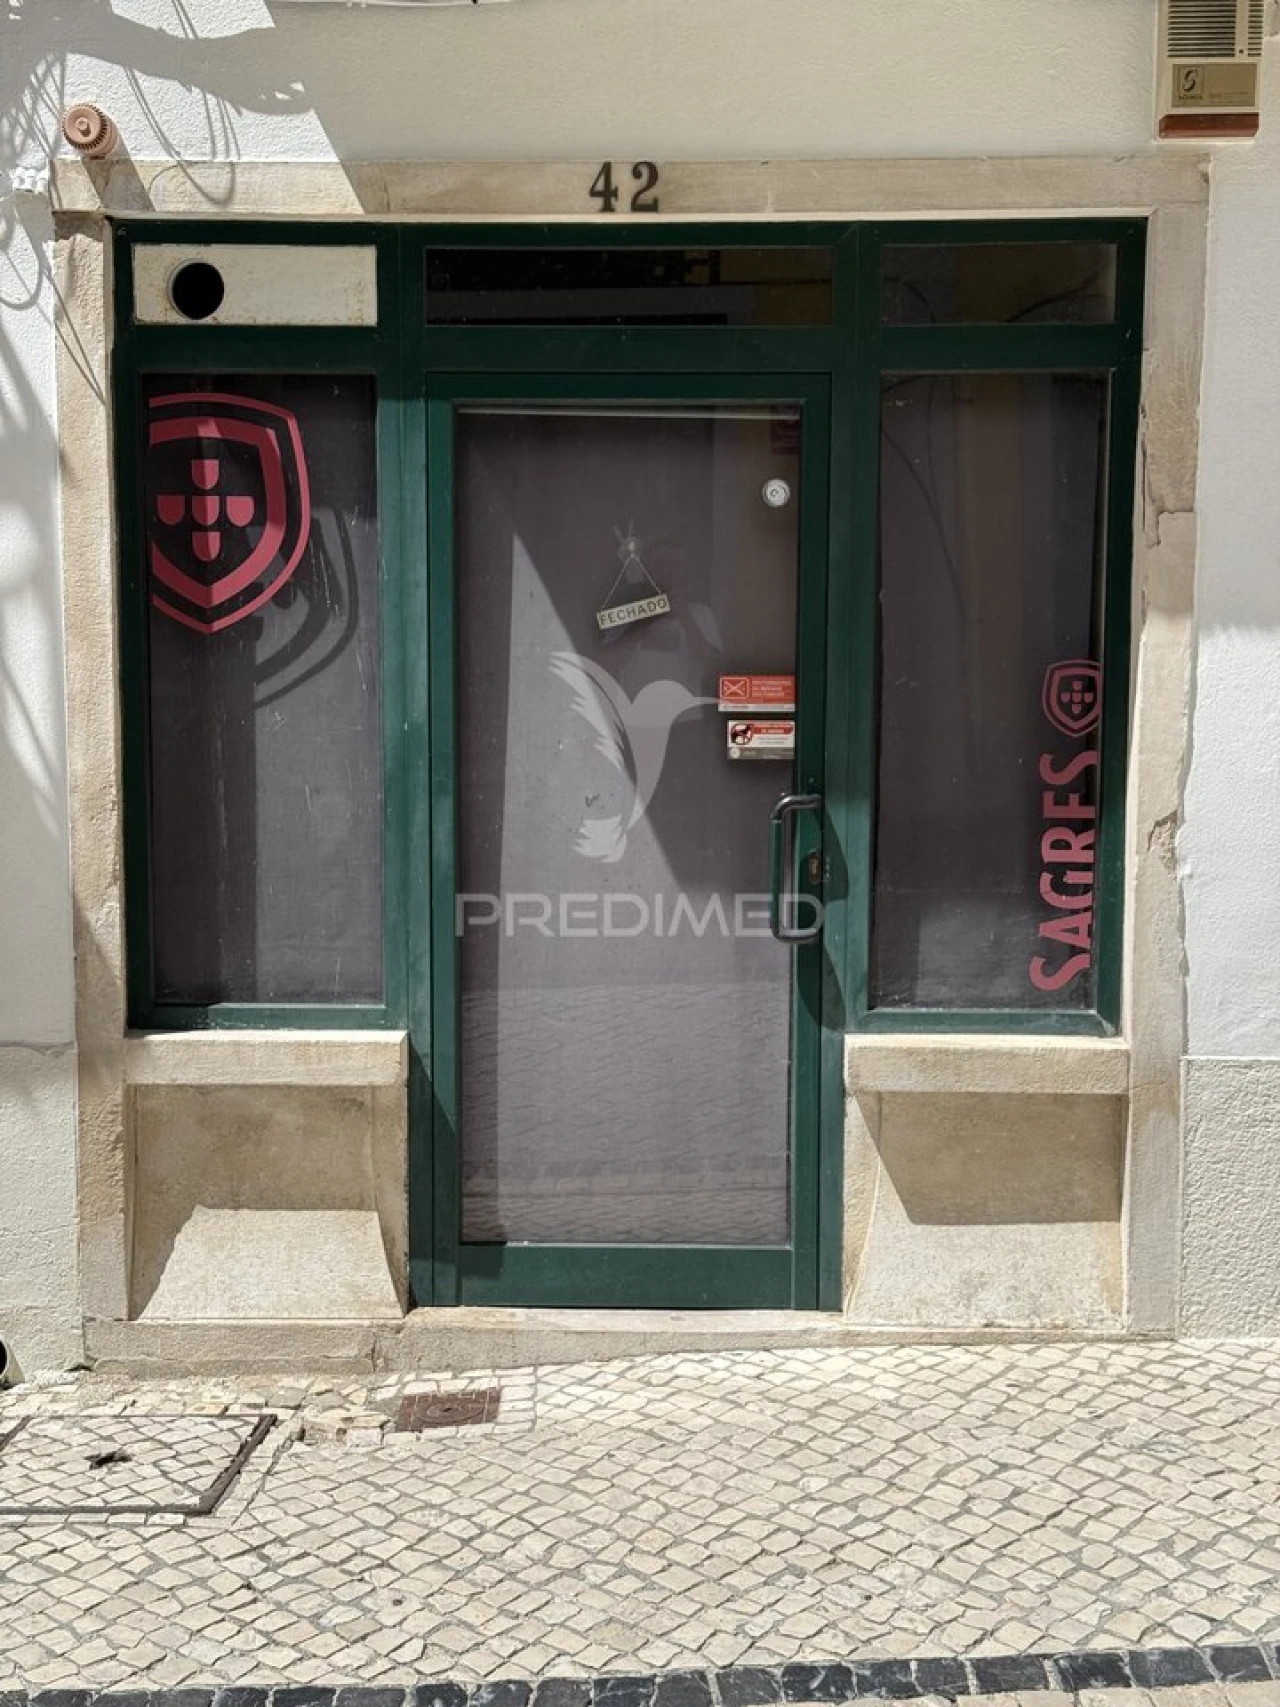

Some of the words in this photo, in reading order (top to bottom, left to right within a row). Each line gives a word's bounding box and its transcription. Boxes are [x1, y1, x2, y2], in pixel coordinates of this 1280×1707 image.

[590, 161, 659, 213] 42
[600, 597, 668, 626] FECHADO
[1029, 750, 1099, 991] SAGRES
